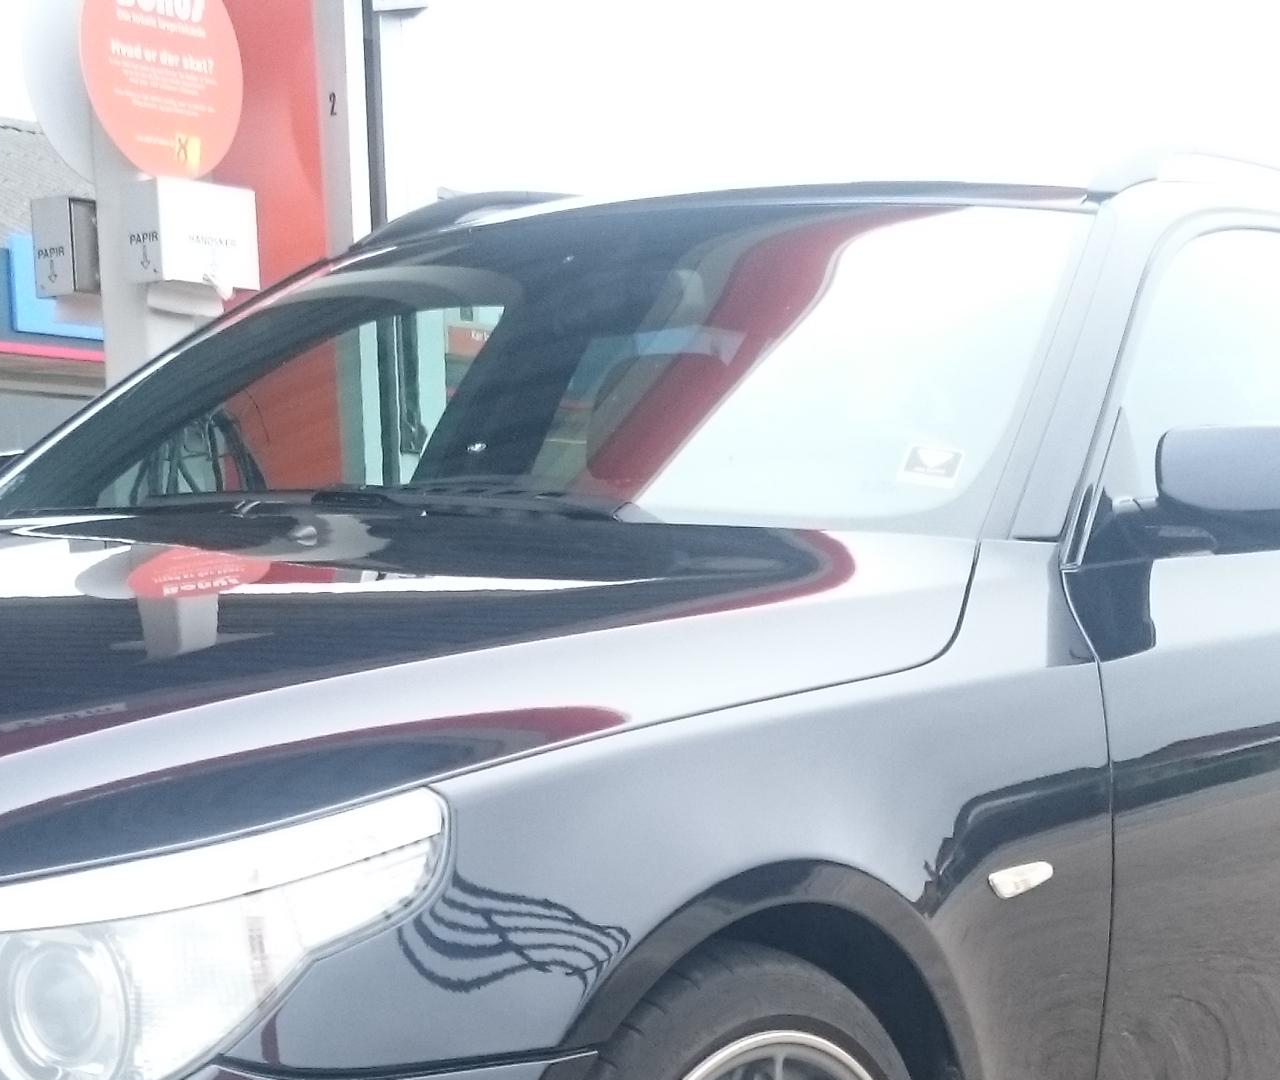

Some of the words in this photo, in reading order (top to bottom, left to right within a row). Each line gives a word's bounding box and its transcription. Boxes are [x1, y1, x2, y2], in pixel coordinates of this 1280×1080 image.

[329, 92, 337, 116] 2
[129, 231, 159, 245] PAPIR
[37, 246, 65, 260] PAPIR
